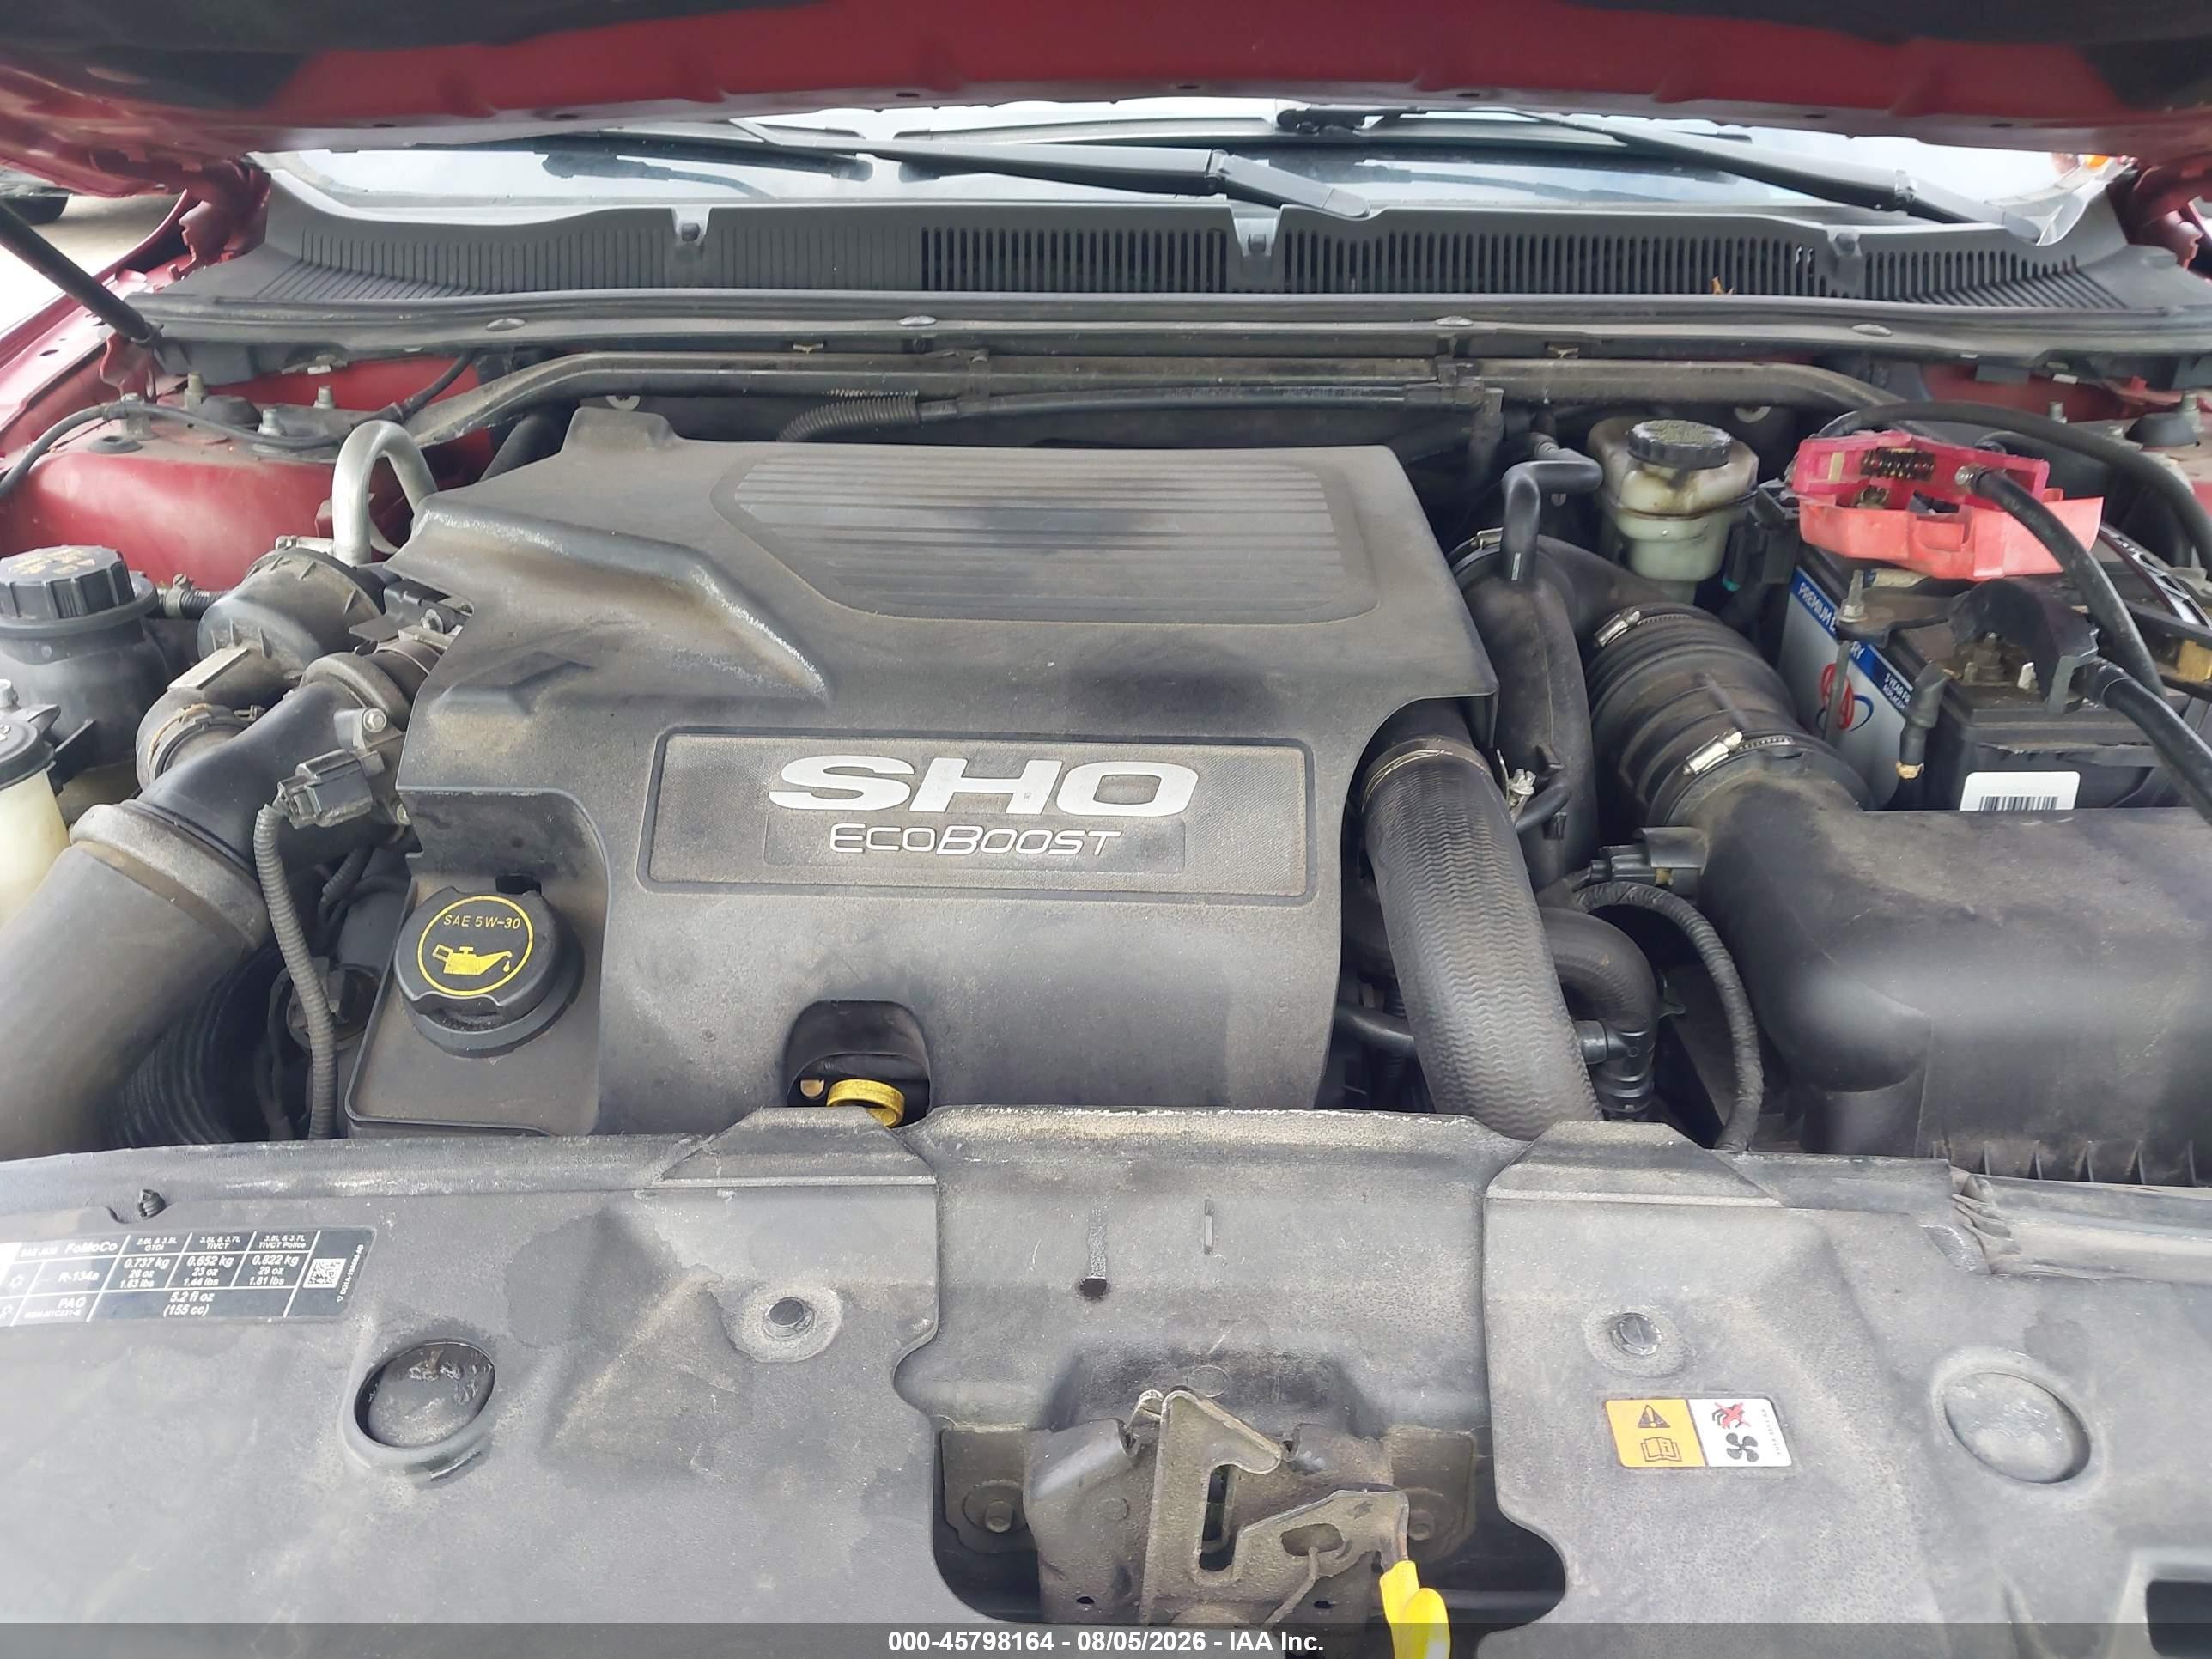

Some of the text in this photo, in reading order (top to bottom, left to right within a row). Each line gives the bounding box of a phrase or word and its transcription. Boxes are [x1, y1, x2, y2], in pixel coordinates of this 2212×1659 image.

[1798, 582, 1832, 628] PREMIUM
[769, 755, 1200, 817] SHO
[443, 914, 521, 930] SAE 5W-30
[64, 1241, 118, 1255] FoMoCo
[124, 1256, 170, 1269] 0.737 kg
[186, 1255, 234, 1268] 0.652 kg
[252, 1254, 300, 1267] 0.822 kg
[58, 1271, 100, 1283] R-134a
[191, 1267, 205, 1277] 23
[258, 1266, 284, 1275] 29 oz
[119, 1279, 155, 1289] 1.63 lbs
[183, 1277, 219, 1286] 1.44 lbs
[249, 1276, 285, 1285] 1.81 lbs
[58, 1297, 87, 1310] PAG
[169, 1291, 215, 1303] 5.2 fl oz
[162, 1304, 210, 1318] (155 cc)
